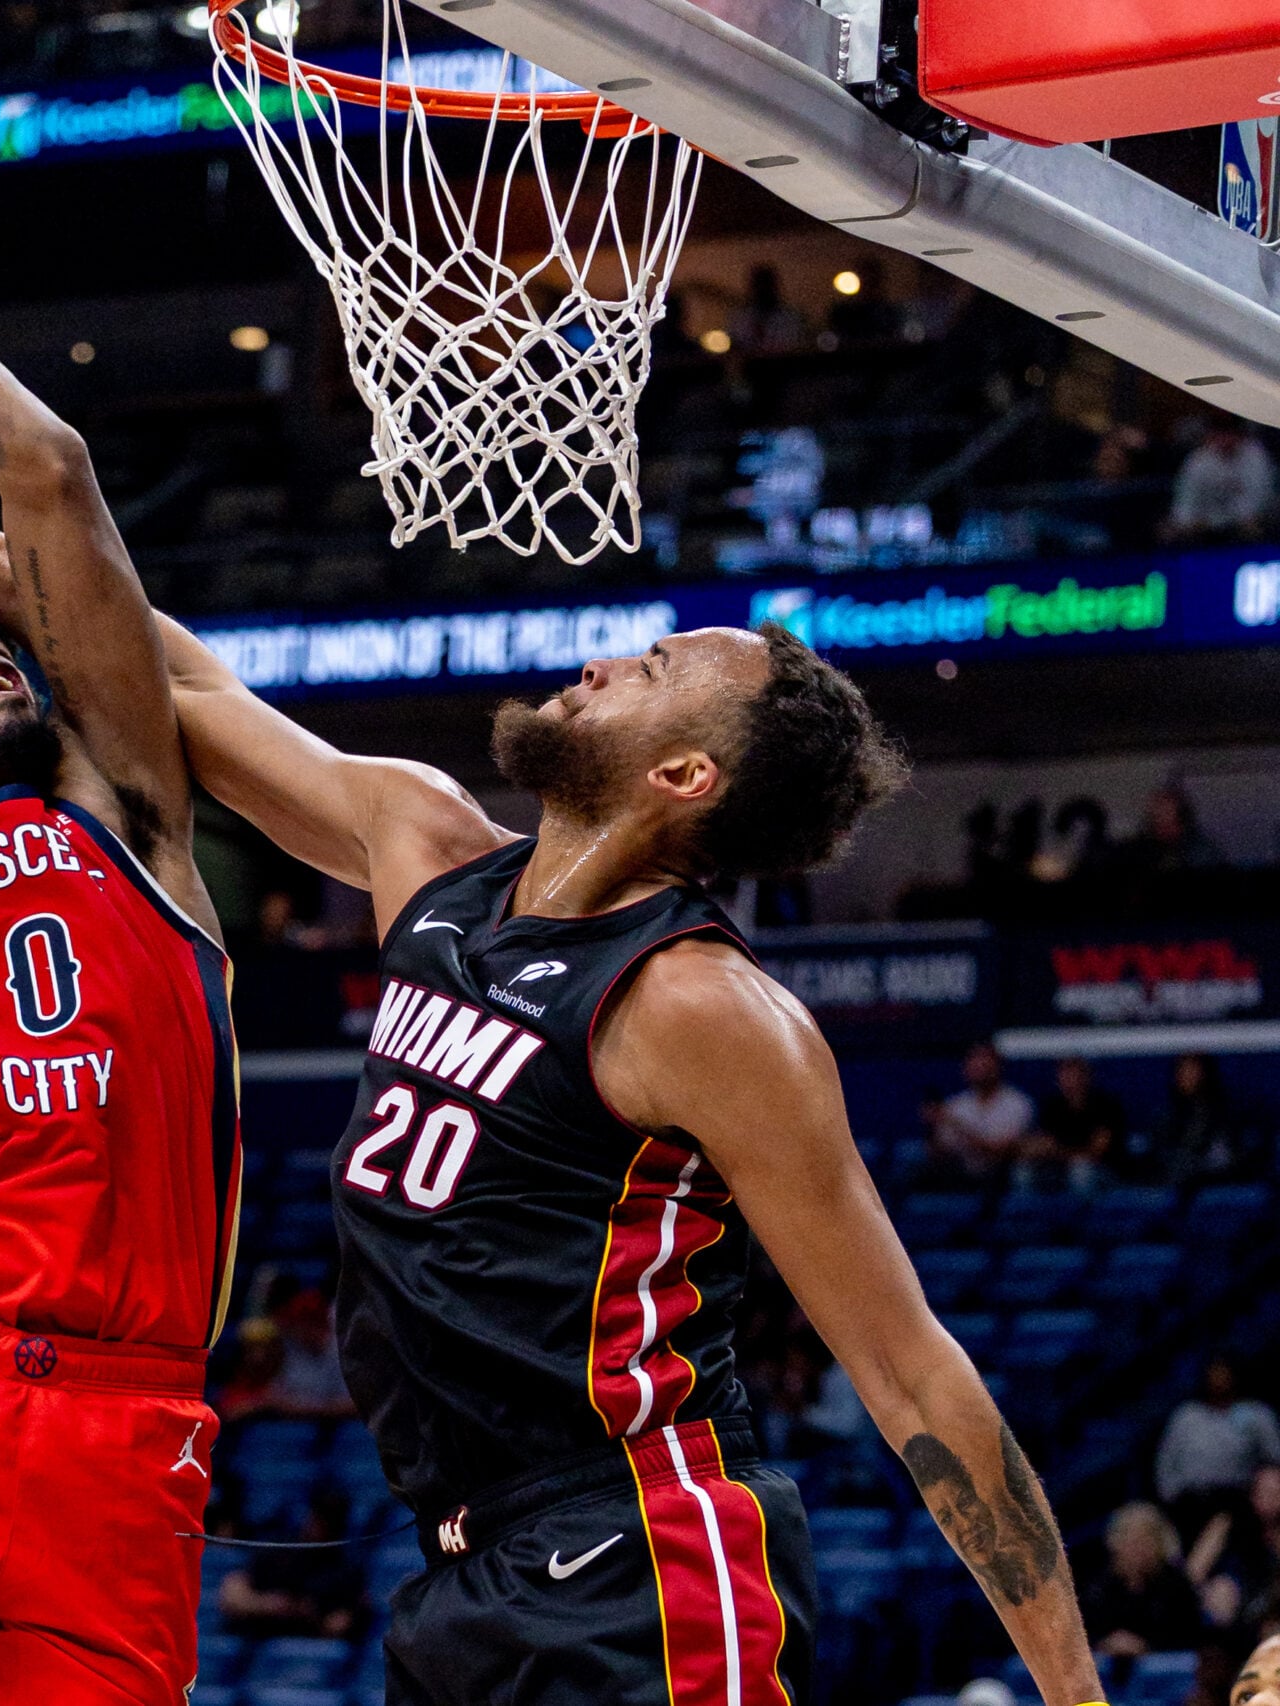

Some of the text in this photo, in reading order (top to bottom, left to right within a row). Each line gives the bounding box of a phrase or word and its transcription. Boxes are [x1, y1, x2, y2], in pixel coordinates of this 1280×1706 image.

[1225, 170, 1251, 221] NBA
[305, 619, 403, 684] UNION
[404, 615, 443, 678] OF
[447, 612, 510, 676] THE
[5, 912, 82, 1037] 0
[487, 983, 546, 1018] Robinhood
[368, 977, 547, 1104] MIAMI
[1, 1048, 114, 1114] CITY
[342, 1081, 481, 1213] 20
